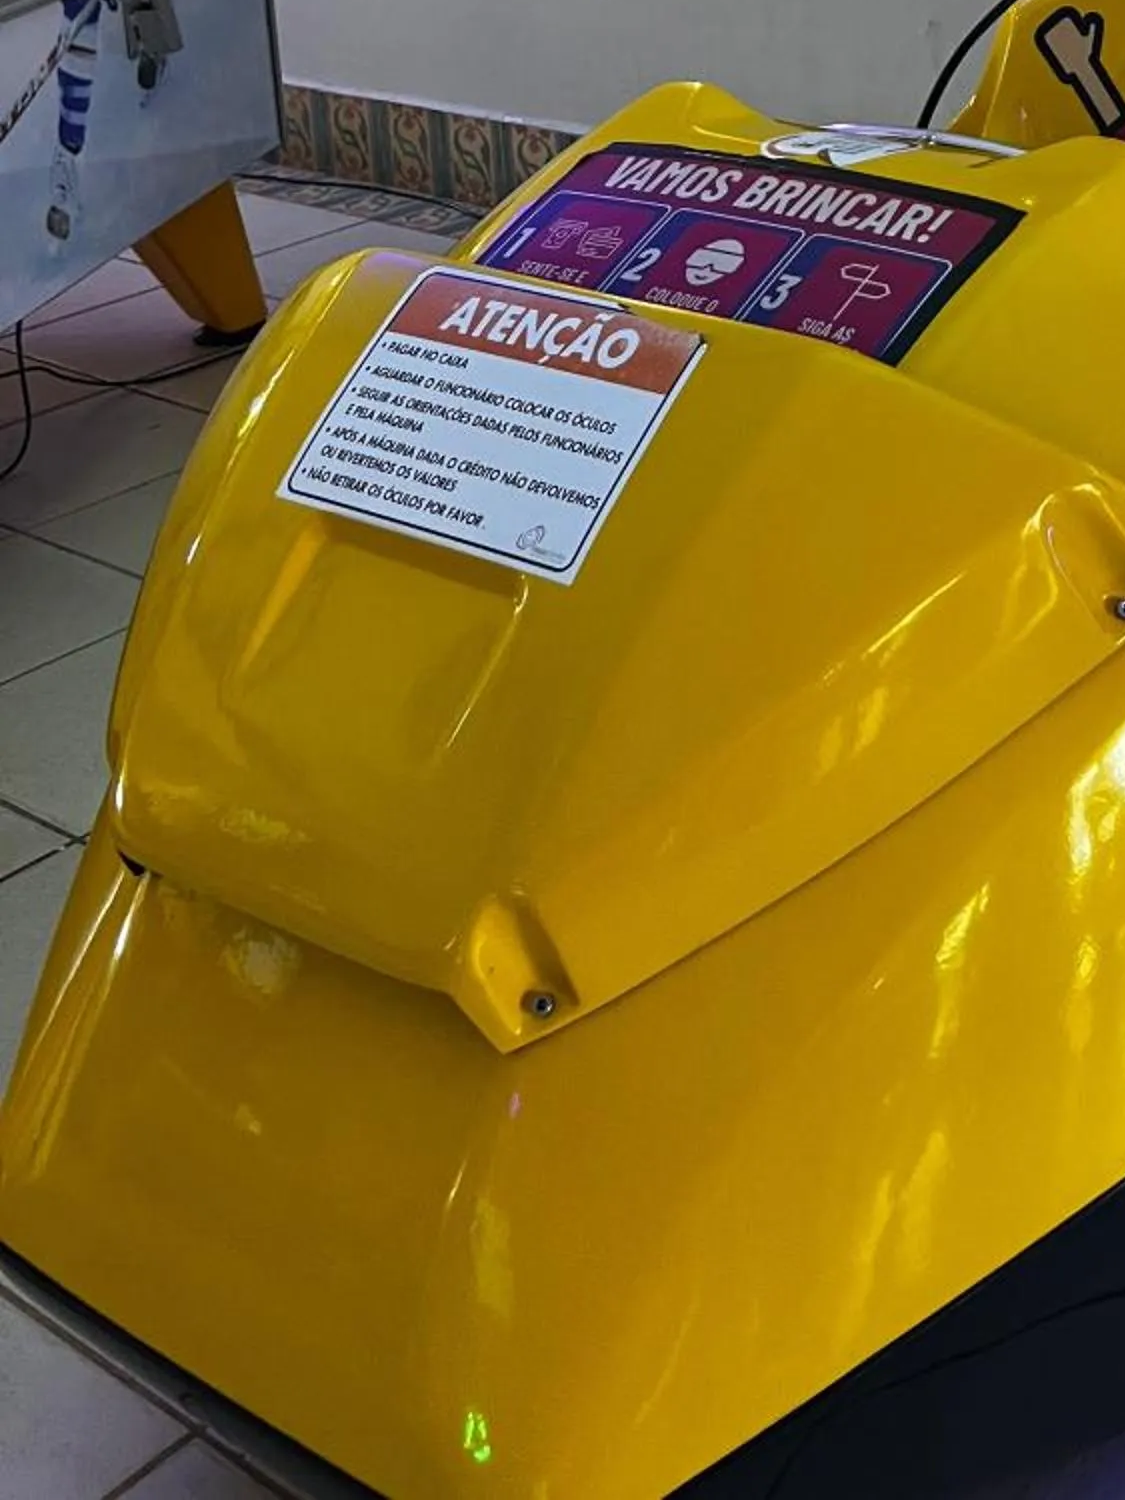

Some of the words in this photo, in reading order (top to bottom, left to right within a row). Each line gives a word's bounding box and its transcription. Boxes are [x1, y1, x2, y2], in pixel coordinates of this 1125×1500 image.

[604, 156, 741, 204] VAMOS
[734, 178, 954, 244] BRINCAR!
[503, 226, 536, 260] 1
[621, 247, 661, 282] 2
[645, 285, 706, 310] COLOQUE
[760, 275, 803, 310] 3
[439, 296, 639, 369] ATENÇÃO
[797, 317, 832, 337] SIGA
[387, 341, 420, 358] PAGAR
[419, 349, 437, 362] NO
[437, 353, 471, 369] CAIXA
[353, 406, 376, 422] PELA
[375, 409, 425, 433] MÁQUINA
[371, 366, 425, 386] AGUARDAR
[434, 379, 505, 406] FUNCIONÁRIO
[504, 396, 557, 418] COLOCAR
[555, 410, 573, 424] OS
[571, 411, 618, 435] ÓCULOS
[355, 384, 391, 402] SEGUIR
[389, 393, 407, 407] AS
[405, 396, 472, 425] ORIENTAÇÕES
[471, 414, 508, 434] DADAS
[508, 424, 545, 443] PELOS
[540, 432, 625, 465] FUNCIONÁRIOS
[320, 445, 338, 458] OU
[337, 448, 395, 475] REVERTEMOS
[394, 465, 412, 479] OS
[412, 468, 459, 493] VALORES
[331, 426, 358, 444] APÓS
[366, 433, 416, 460] MÁQUINA
[415, 448, 447, 467] DADA
[457, 457, 501, 482] CRÉDITO
[500, 470, 527, 490] NÃO
[526, 479, 601, 510] DEVOLVEMOS
[307, 465, 331, 483] NÃO
[329, 471, 369, 494] RETIRAR
[367, 483, 383, 497] OS
[382, 486, 425, 511] ÓCULOS
[422, 499, 447, 517] POR
